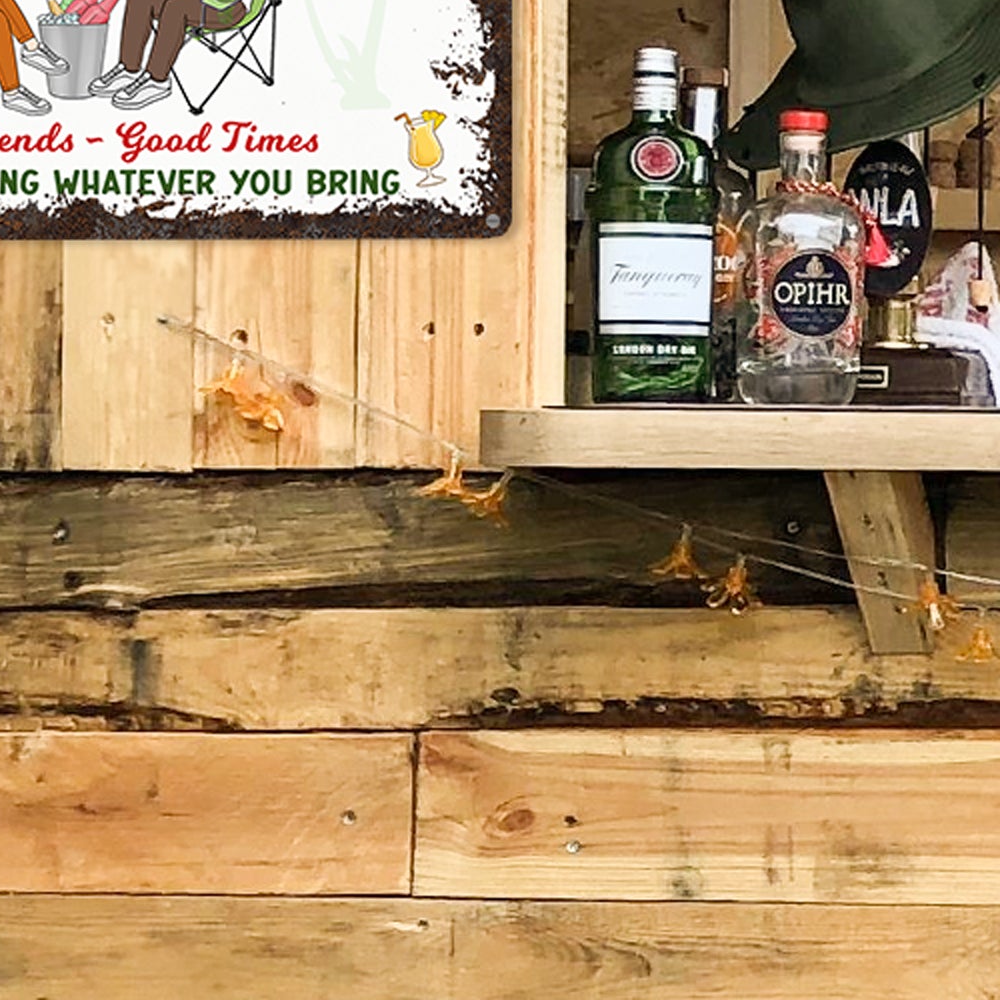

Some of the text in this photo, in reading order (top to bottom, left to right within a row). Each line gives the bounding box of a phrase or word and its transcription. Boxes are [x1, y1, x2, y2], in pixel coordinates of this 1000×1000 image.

[115, 121, 213, 164] Good
[222, 121, 319, 153] Times
[52, 169, 217, 197] WHATEVER
[229, 169, 292, 197] YOU
[307, 169, 401, 198] BRING
[773, 281, 851, 306] OPIHR
